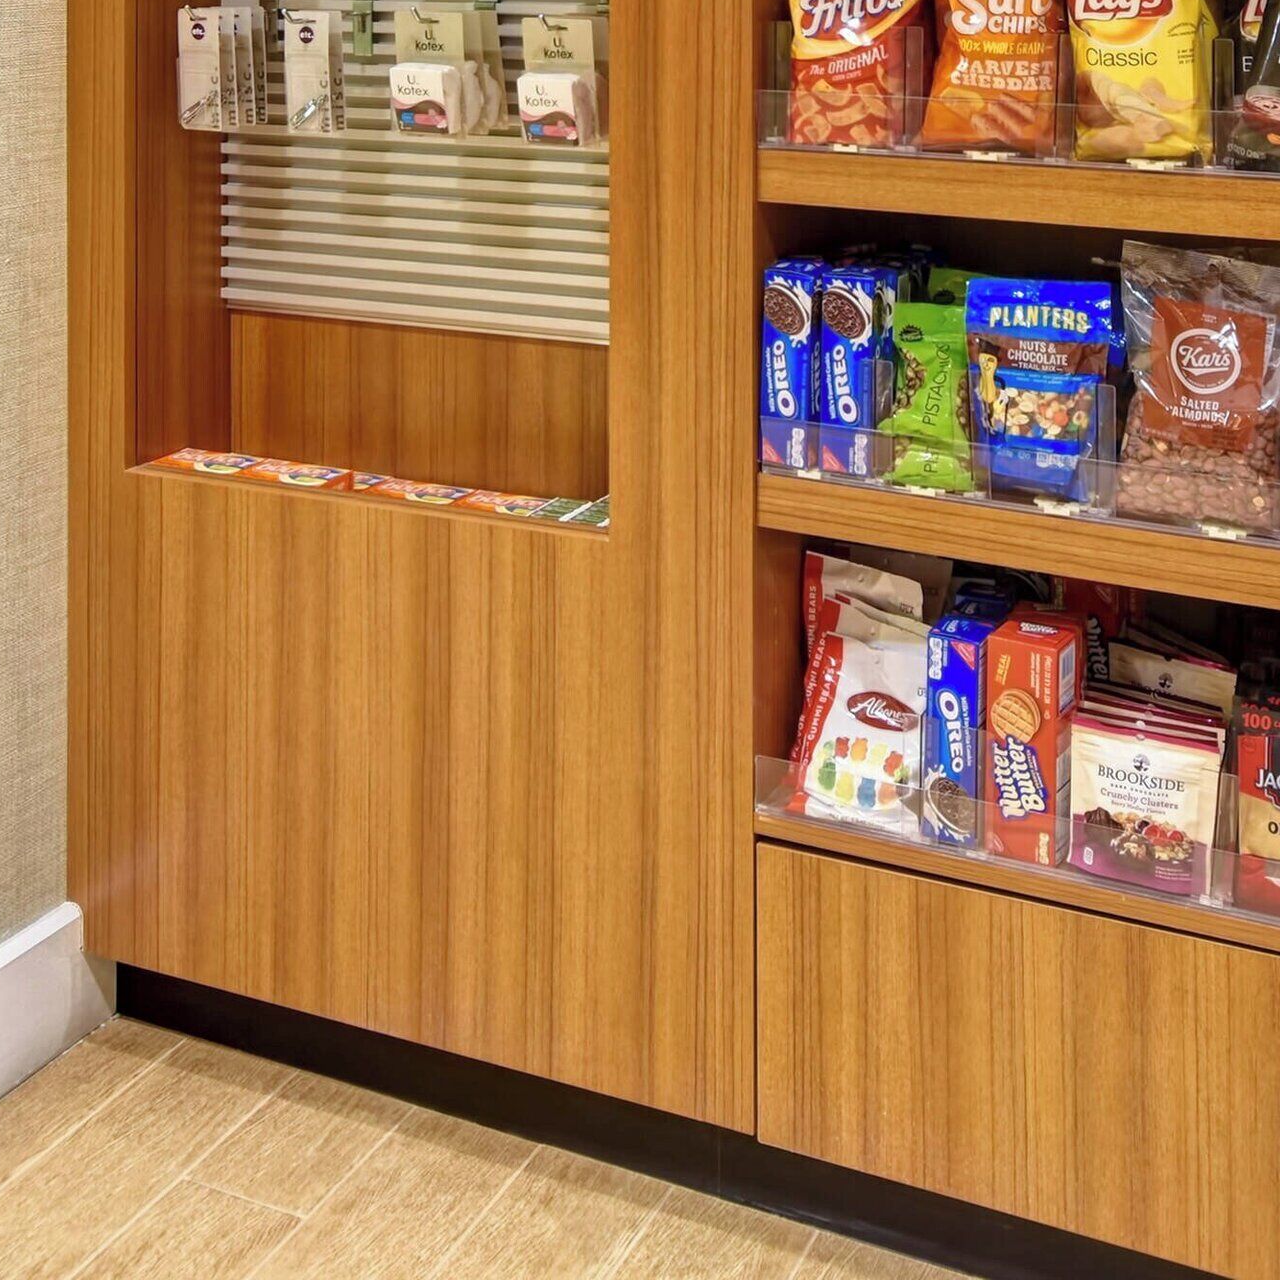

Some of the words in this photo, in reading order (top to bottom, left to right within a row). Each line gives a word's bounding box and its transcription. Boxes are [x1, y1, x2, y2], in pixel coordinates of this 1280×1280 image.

[988, 16, 1047, 33] CHIPS
[983, 40, 1014, 54] WHOLE
[1016, 41, 1045, 54] GRAIN
[1086, 47, 1158, 68] Classic
[828, 45, 888, 74] ORIGINAL
[956, 56, 1053, 76] HARVEST
[950, 72, 1053, 91] CHEDDAR
[989, 306, 1091, 334] PLANTERS
[1007, 349, 1068, 366] CHOCOLATE
[1019, 340, 1046, 352] NUTS
[1047, 342, 1056, 353] &
[1178, 345, 1231, 369] Kar's
[1042, 363, 1056, 371] MIX
[773, 340, 796, 418] OREO
[832, 345, 858, 423] OREO
[922, 343, 950, 426] PISTACHIOS
[1180, 395, 1220, 410] SALTED
[1172, 408, 1226, 422] ALMONDS
[807, 705, 824, 741] GUMMI
[1242, 712, 1271, 730] 100
[937, 691, 964, 774] OREO
[993, 743, 1026, 817] Nutter
[1006, 736, 1046, 813] Butter
[1098, 764, 1185, 793] BROOKSIDE
[1100, 788, 1139, 804] Crunchy
[1140, 796, 1179, 810] Clusters
